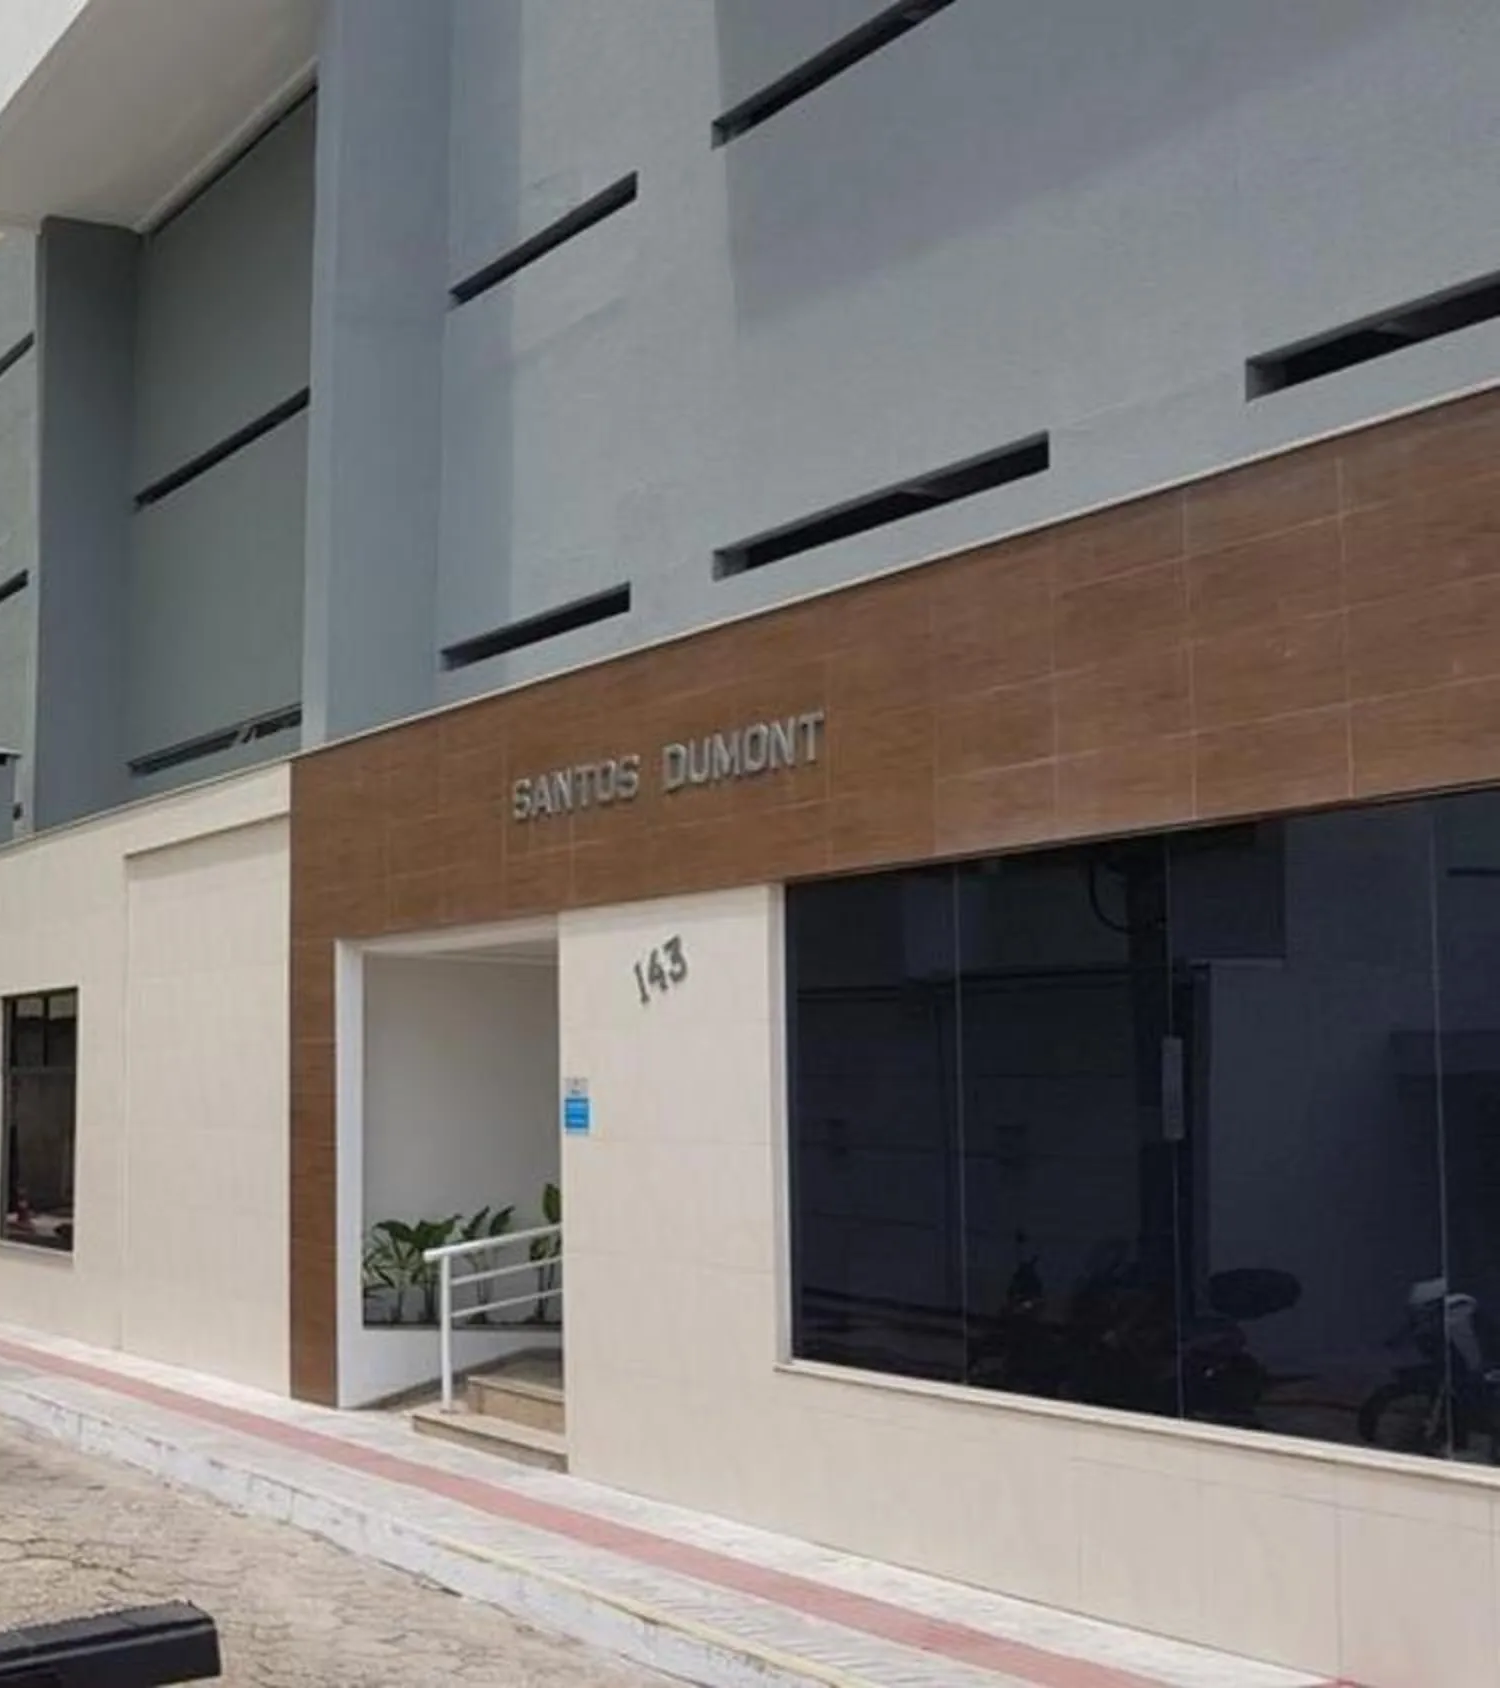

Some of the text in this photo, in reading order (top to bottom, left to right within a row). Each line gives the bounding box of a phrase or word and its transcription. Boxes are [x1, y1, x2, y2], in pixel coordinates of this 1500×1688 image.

[512, 711, 825, 821] SANTOS DUMONT
[632, 935, 688, 1004] 143
